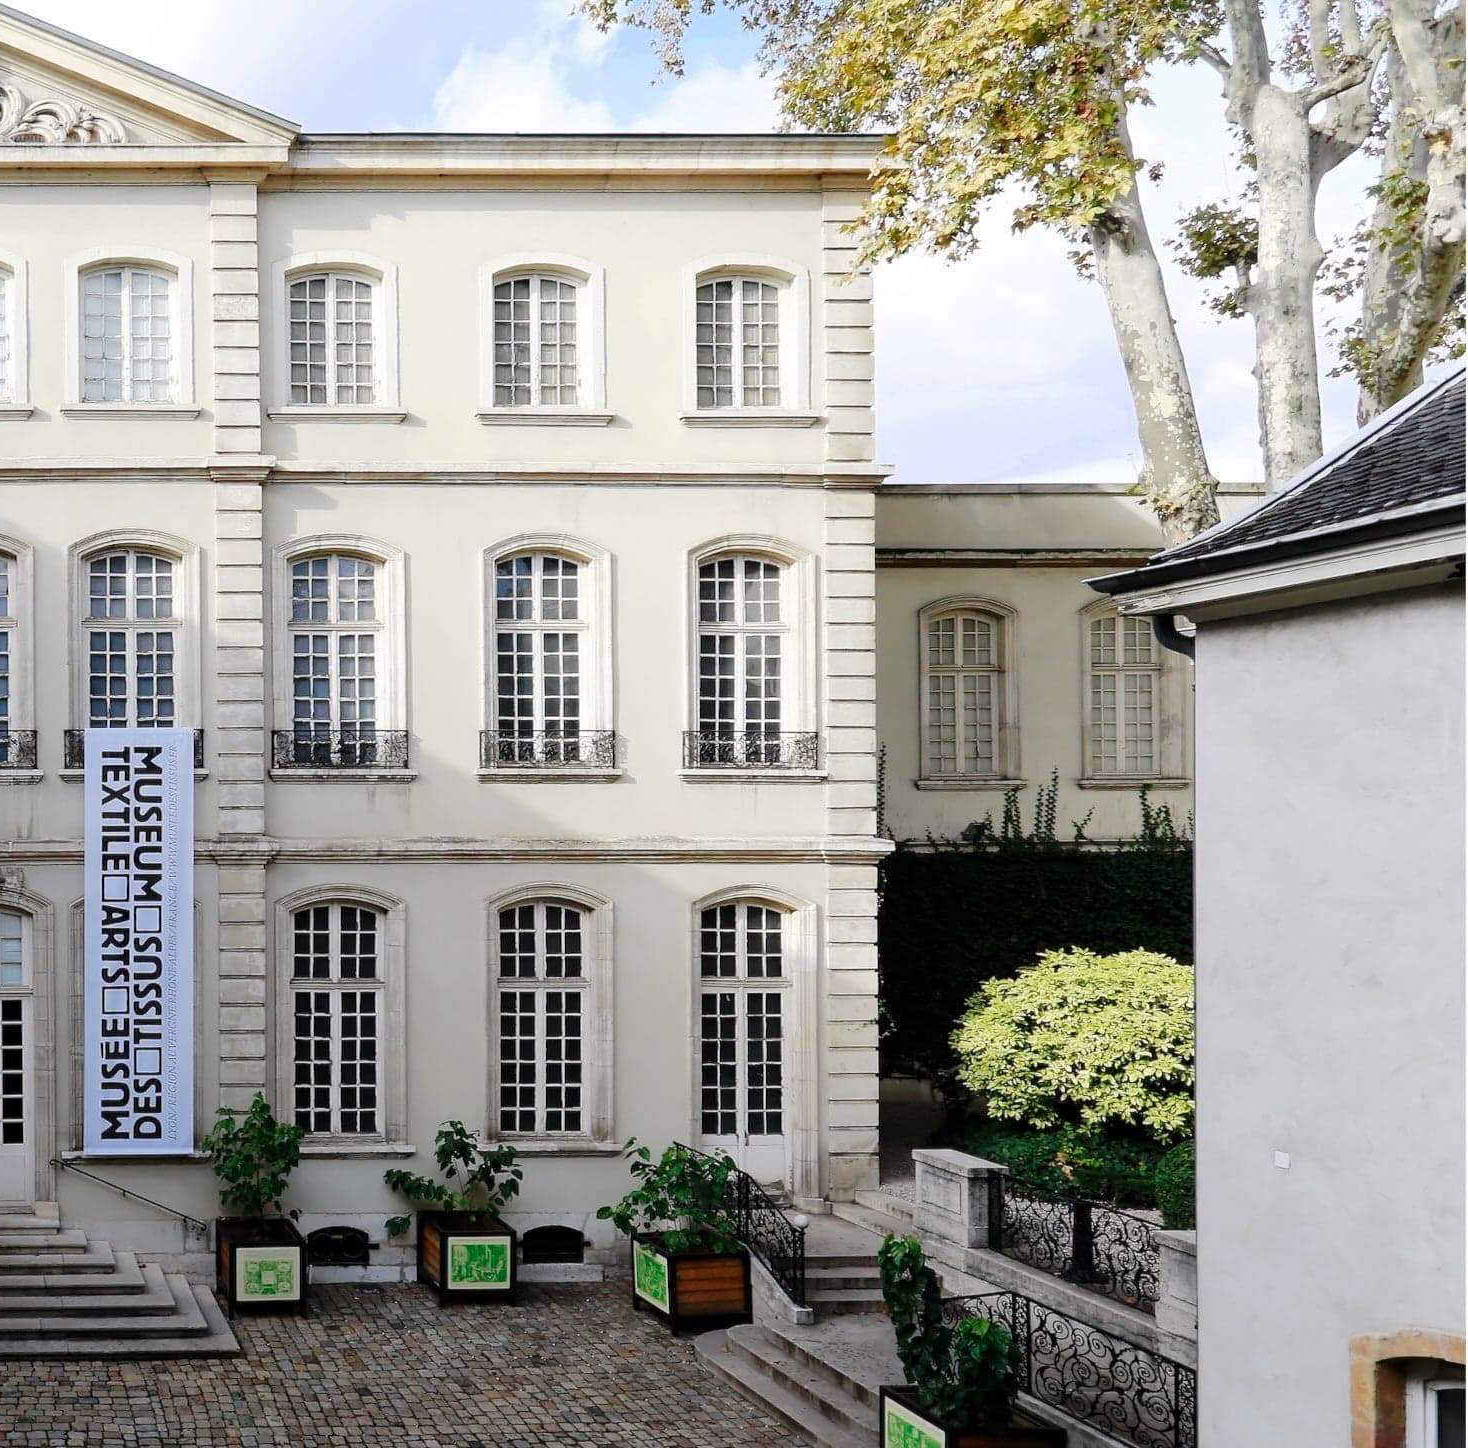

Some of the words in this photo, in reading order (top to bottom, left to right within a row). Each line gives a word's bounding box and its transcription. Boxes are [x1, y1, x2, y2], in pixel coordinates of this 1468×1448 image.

[101, 747, 129, 870] TEXTILE
[134, 747, 162, 901] MUSEUM
[101, 905, 129, 982] ARTS
[134, 937, 162, 1044] TISSUS
[100, 1018, 130, 1139] MUSÉE
[133, 1078, 162, 1139] DES
